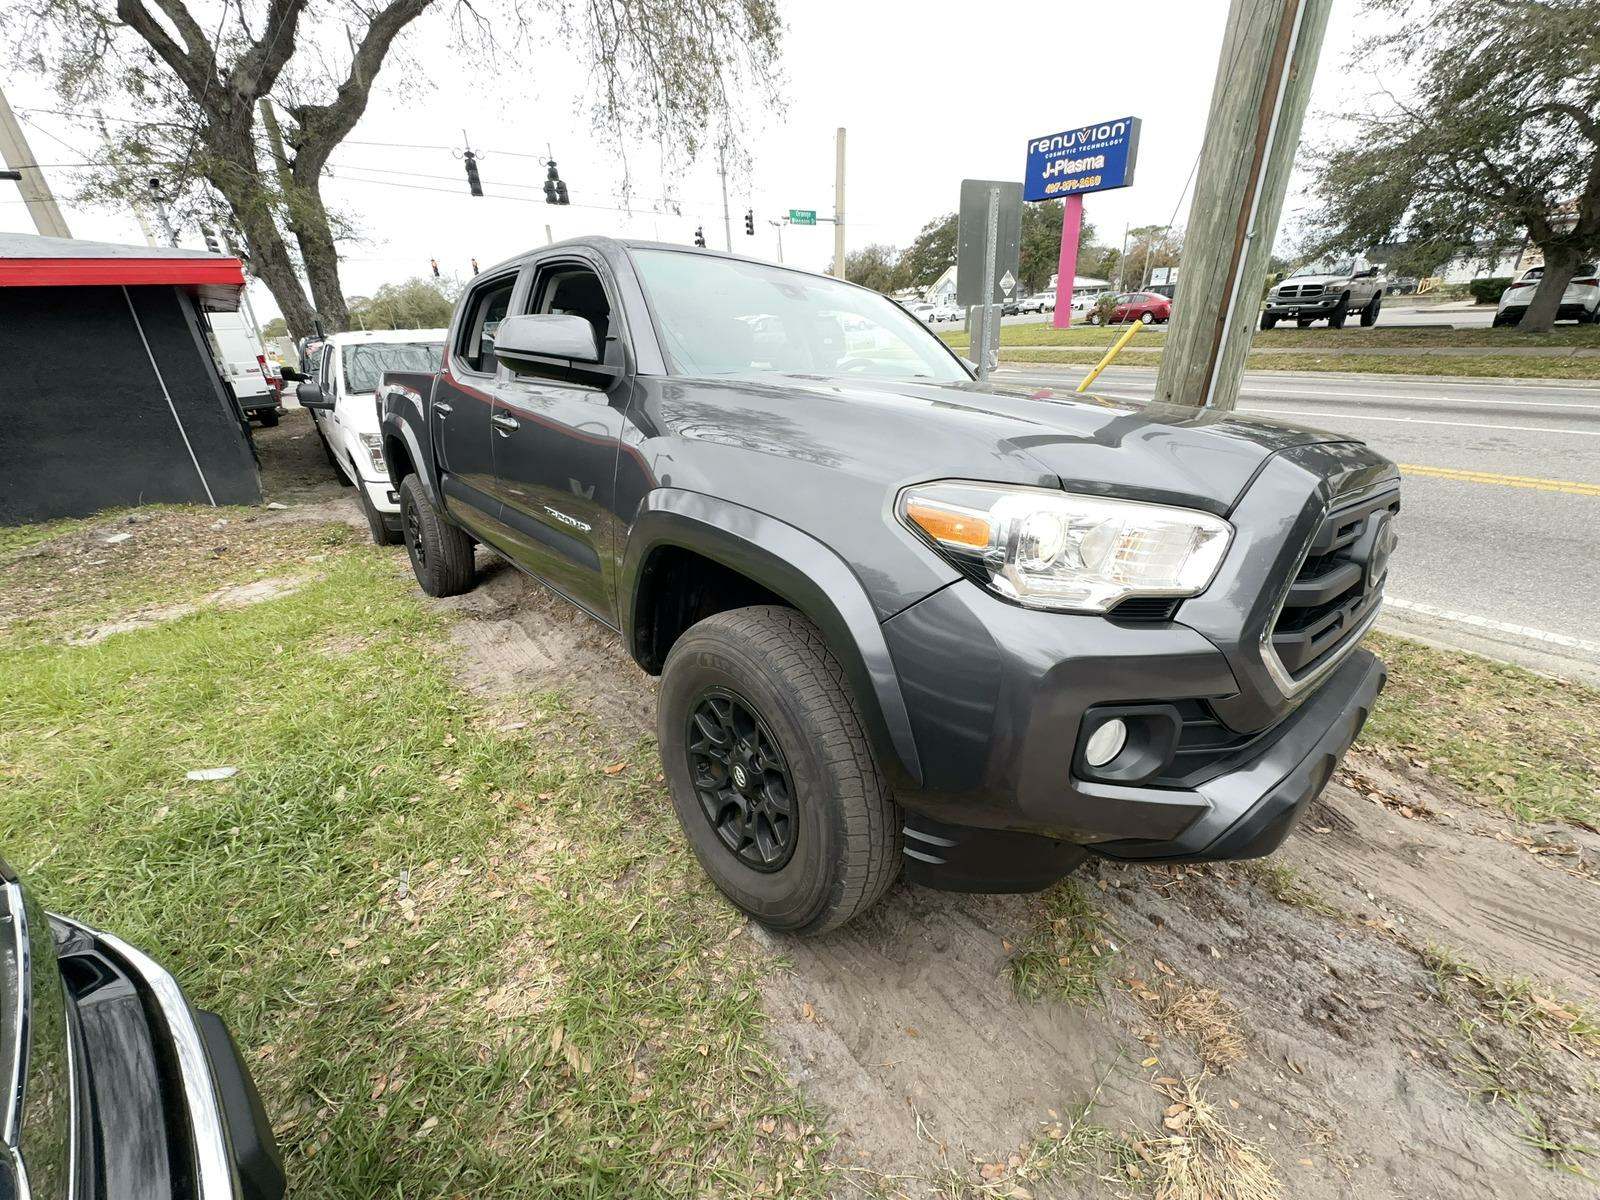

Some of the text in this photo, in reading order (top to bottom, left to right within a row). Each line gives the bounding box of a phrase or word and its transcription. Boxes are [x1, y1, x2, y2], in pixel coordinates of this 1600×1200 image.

[1045, 138, 1123, 159] COSMETIC TECHNOLOGY
[1042, 154, 1105, 179] J-Plasma
